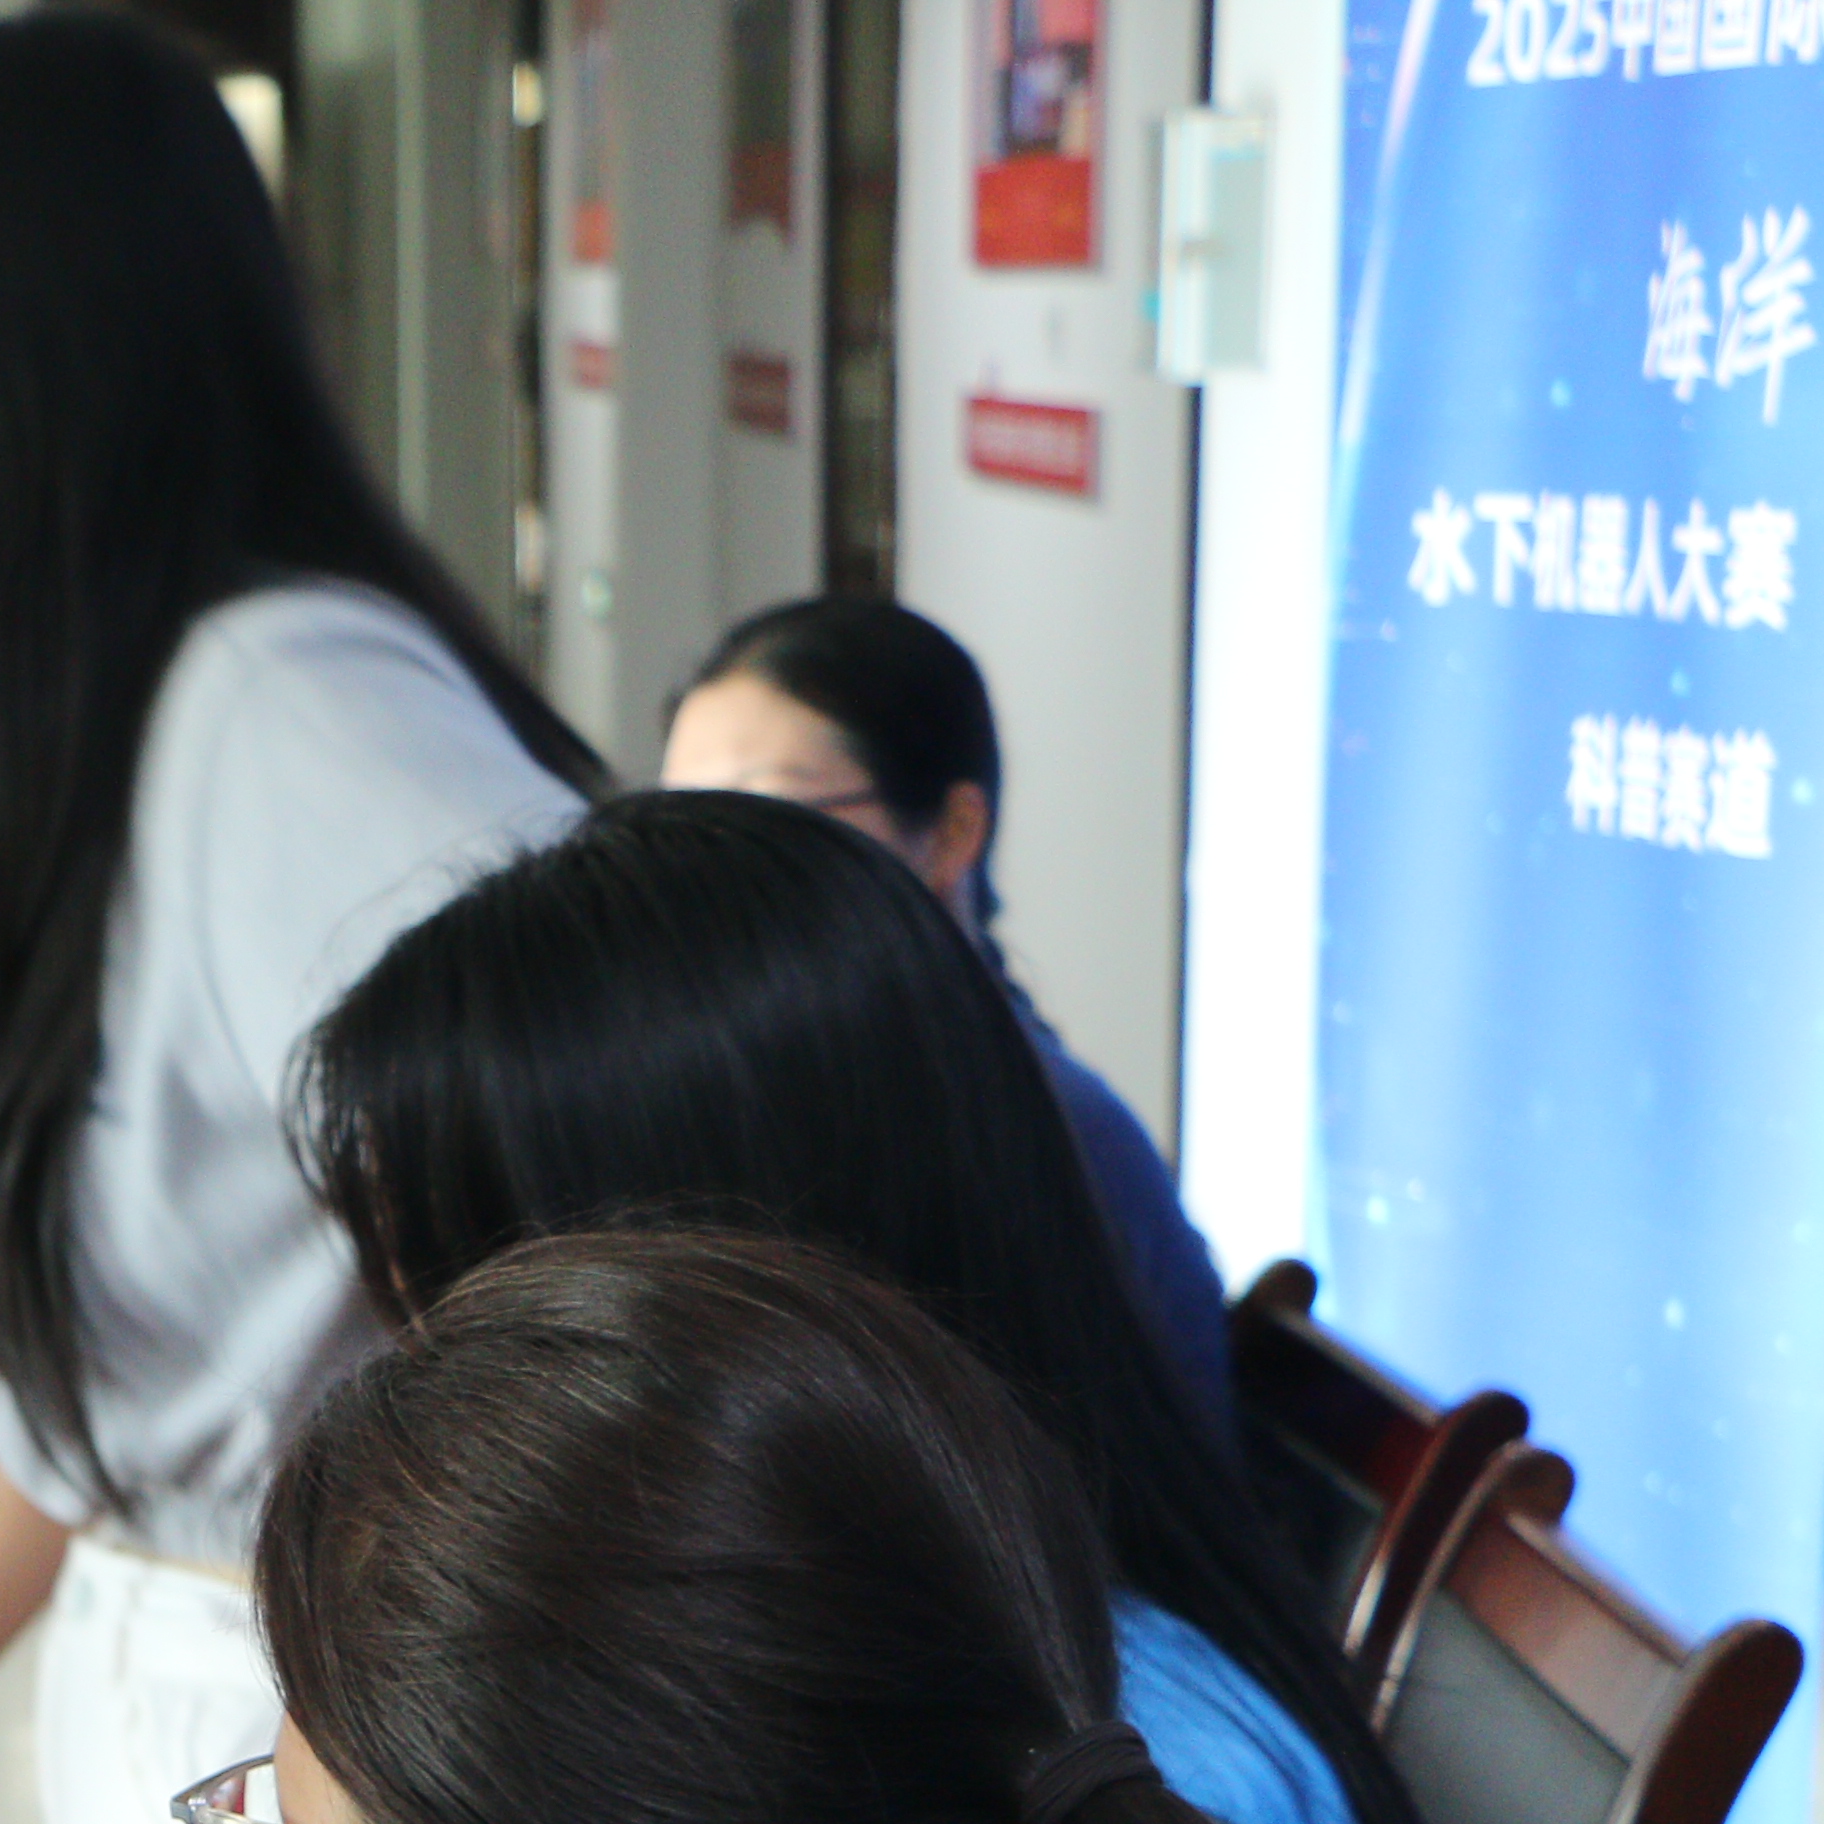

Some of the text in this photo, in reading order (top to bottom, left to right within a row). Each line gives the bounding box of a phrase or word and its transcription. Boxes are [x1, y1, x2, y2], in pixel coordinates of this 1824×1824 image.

[1643, 204, 1817, 427] 海洋
[1408, 486, 1797, 632] 水下机器人大赛
[1566, 711, 1777, 861] 科普赛道
